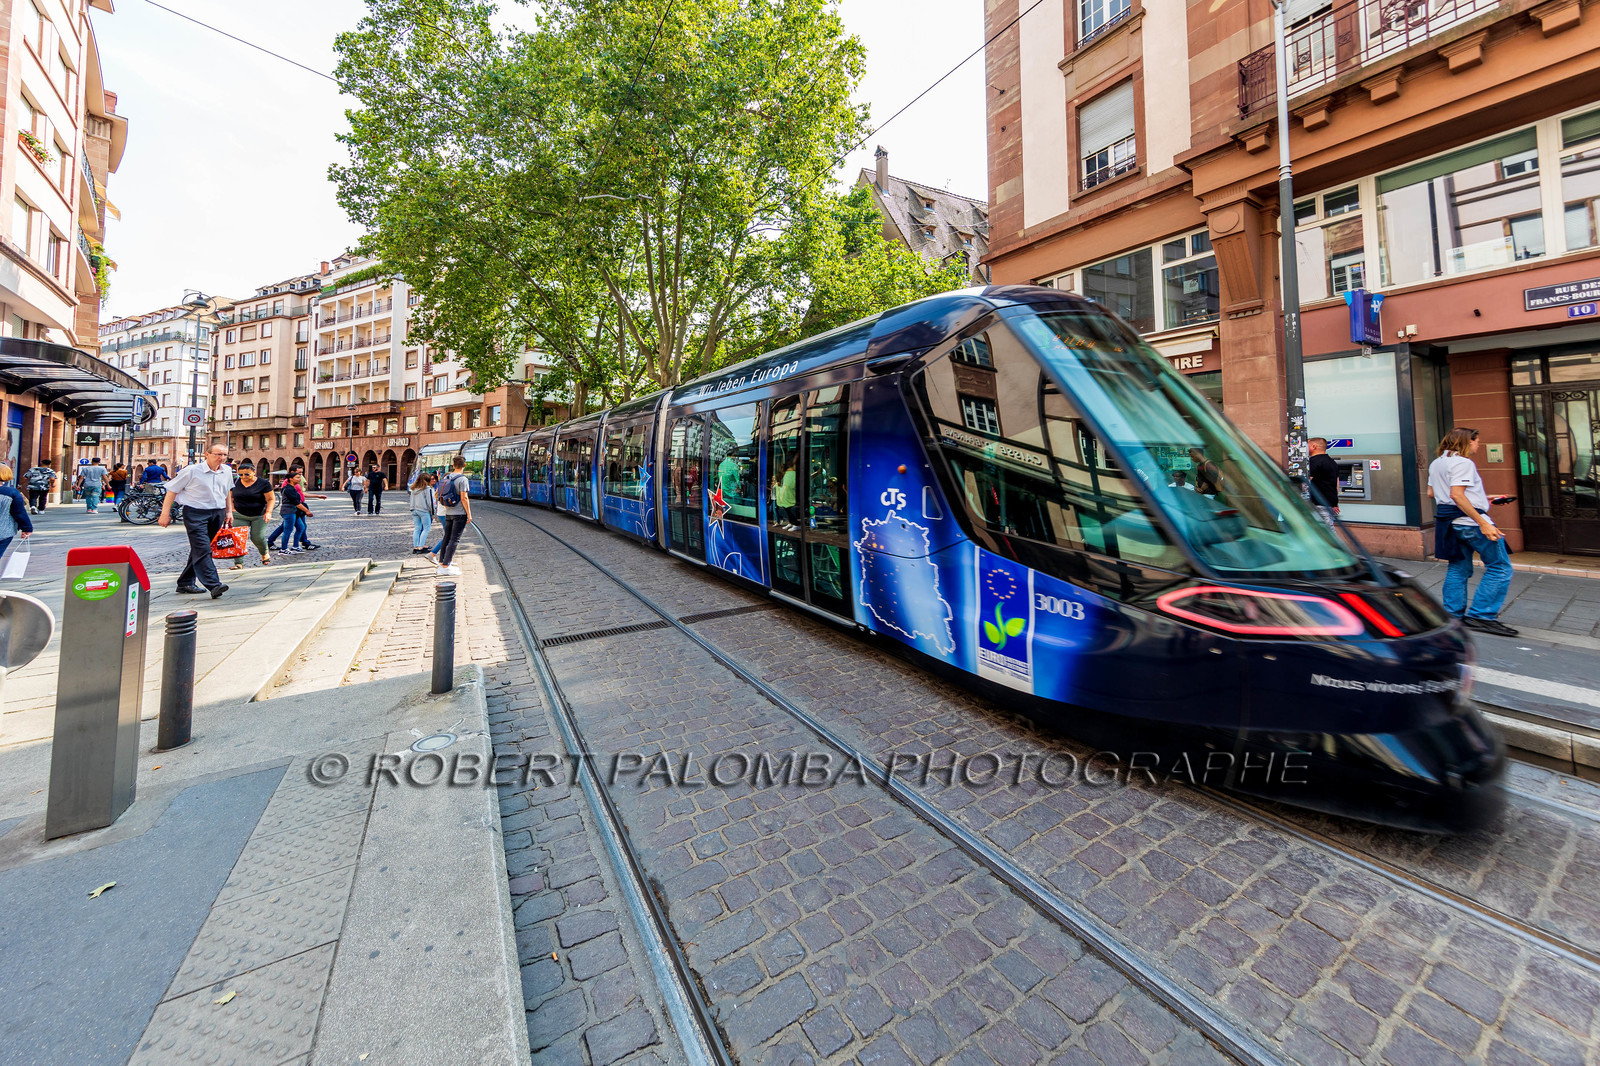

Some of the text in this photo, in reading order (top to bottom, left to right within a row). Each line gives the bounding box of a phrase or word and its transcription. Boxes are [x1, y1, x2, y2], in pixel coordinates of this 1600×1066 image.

[1555, 285, 1578, 294] RUE
[1573, 305, 1591, 316] 10
[1167, 354, 1203, 370] IRE
[699, 360, 799, 397] Wir leben Europa
[880, 488, 907, 511] CTS
[1034, 593, 1085, 621] 3003
